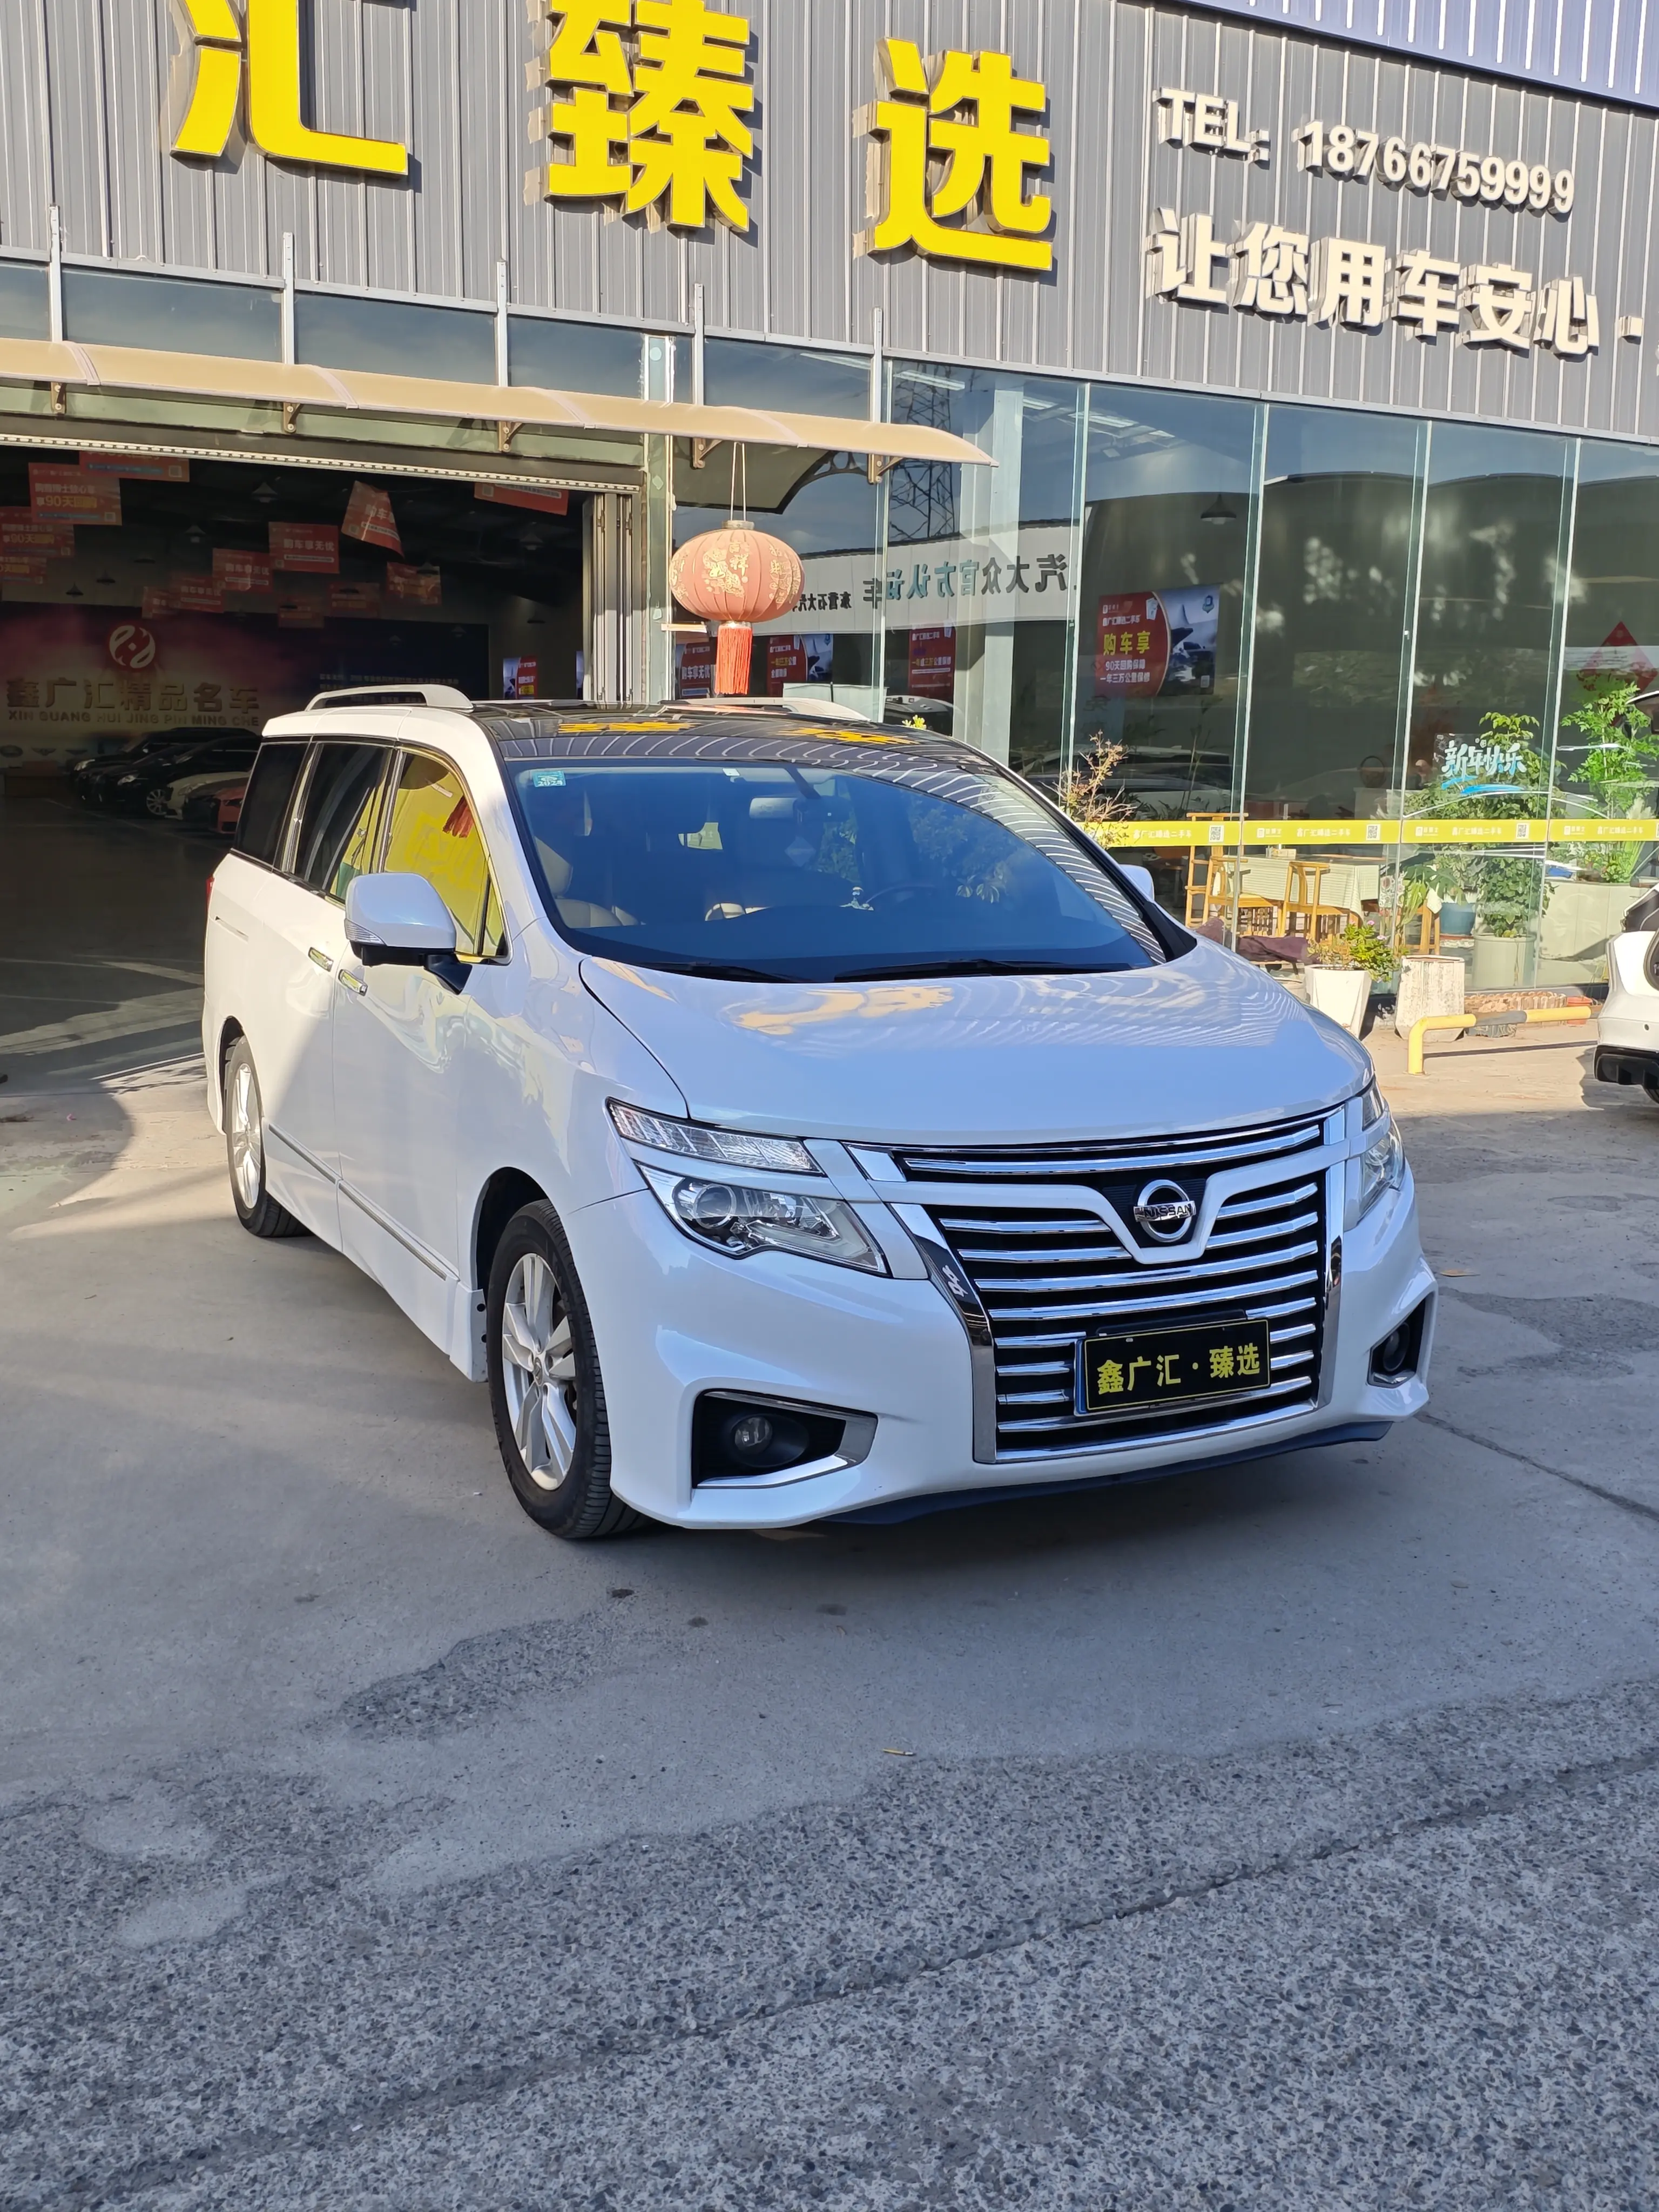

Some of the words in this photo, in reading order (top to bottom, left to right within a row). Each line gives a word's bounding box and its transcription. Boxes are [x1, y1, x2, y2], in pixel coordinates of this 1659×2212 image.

[1296, 119, 1575, 214] 18766759999
[1150, 207, 1659, 375] 让您用车安心·
[1103, 630, 1151, 656] 购车享
[6, 677, 260, 714] 鑫广汇精品名车
[9, 710, 33, 720] XIN
[97, 712, 121, 723] HUI
[192, 716, 226, 726] MING
[232, 716, 259, 727] CHE
[1441, 740, 1527, 781] 新年快乐
[1144, 1203, 1192, 1217] NISSAN
[1097, 1343, 1260, 1395] 鑫广汇·臻选
